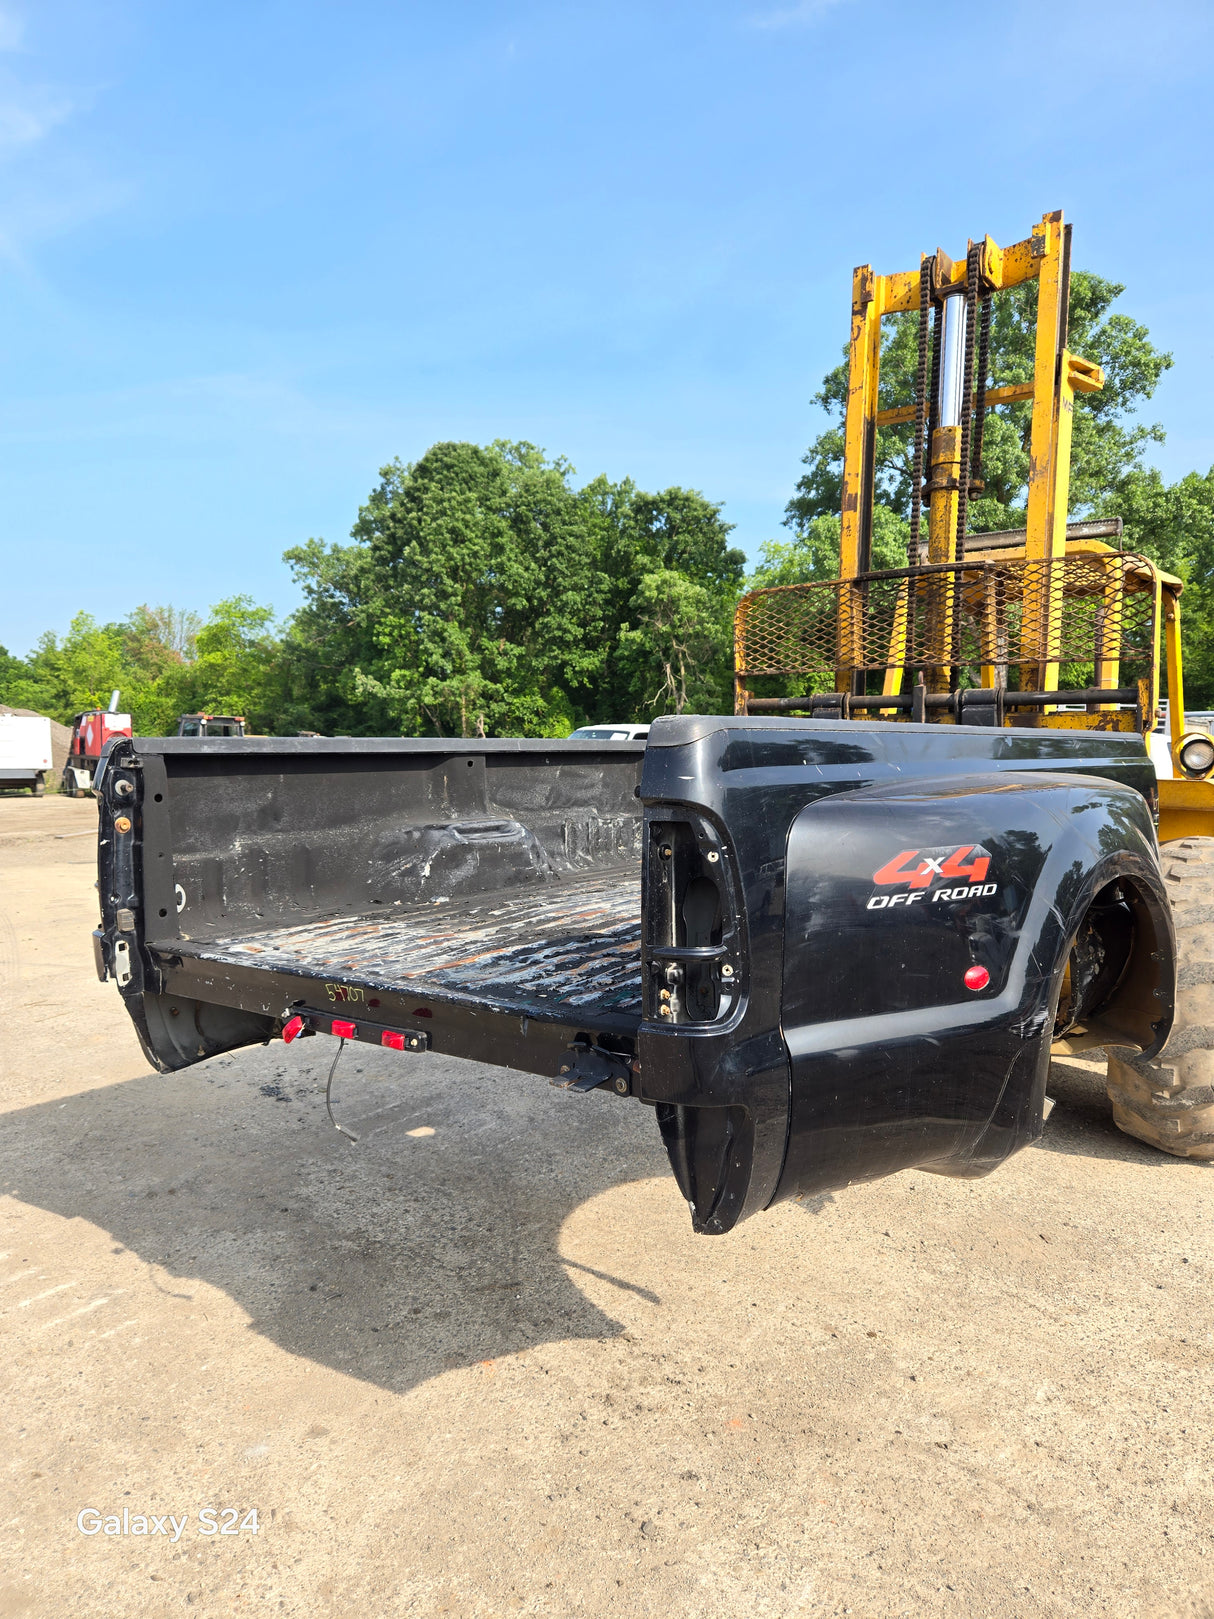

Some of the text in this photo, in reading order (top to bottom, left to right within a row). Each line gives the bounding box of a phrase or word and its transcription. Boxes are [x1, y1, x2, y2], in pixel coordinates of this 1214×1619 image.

[867, 884, 998, 910] OFF ROAD
[325, 983, 364, 1002] 54707
